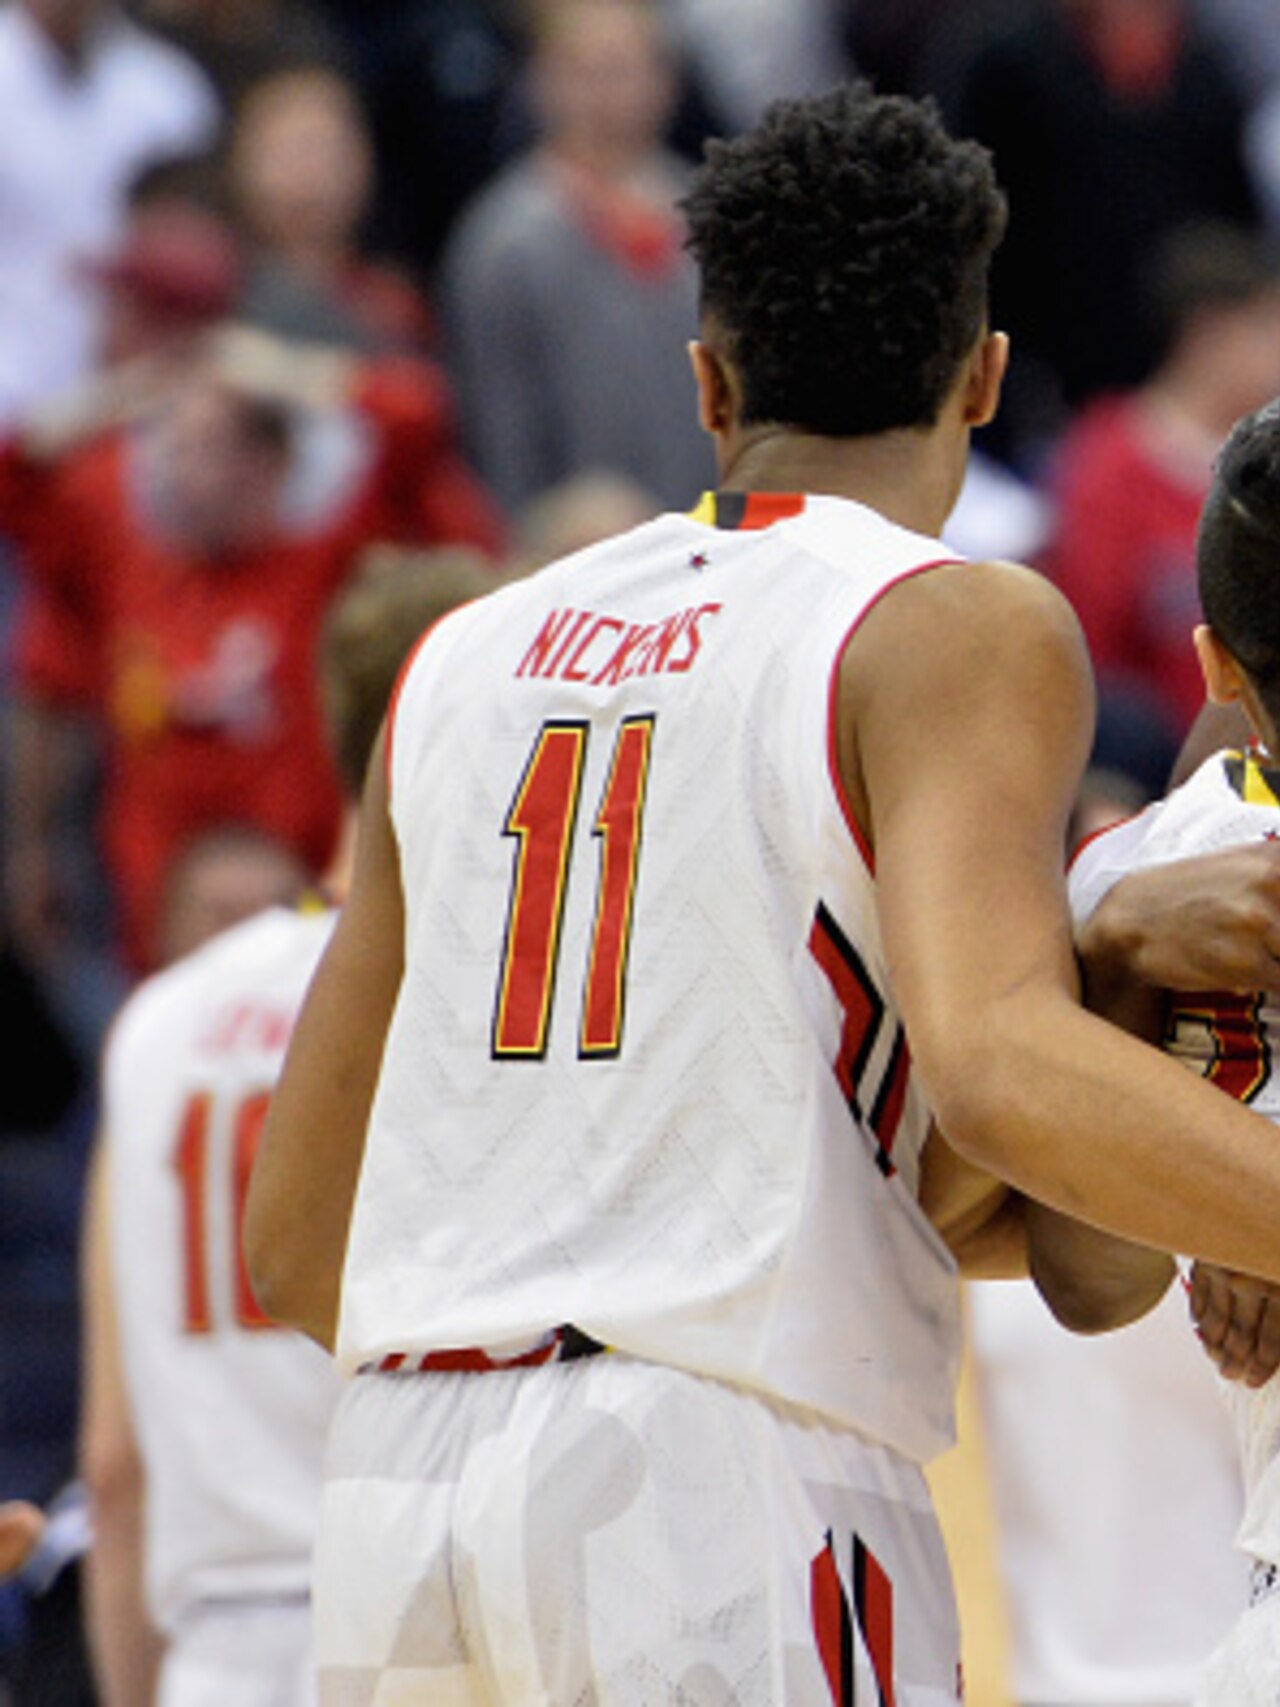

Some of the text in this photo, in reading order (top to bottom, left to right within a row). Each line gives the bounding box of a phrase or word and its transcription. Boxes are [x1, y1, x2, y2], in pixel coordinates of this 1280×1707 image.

[515, 603, 724, 687] NICKNS
[491, 711, 656, 1061] 11
[168, 1088, 288, 1335] 1
